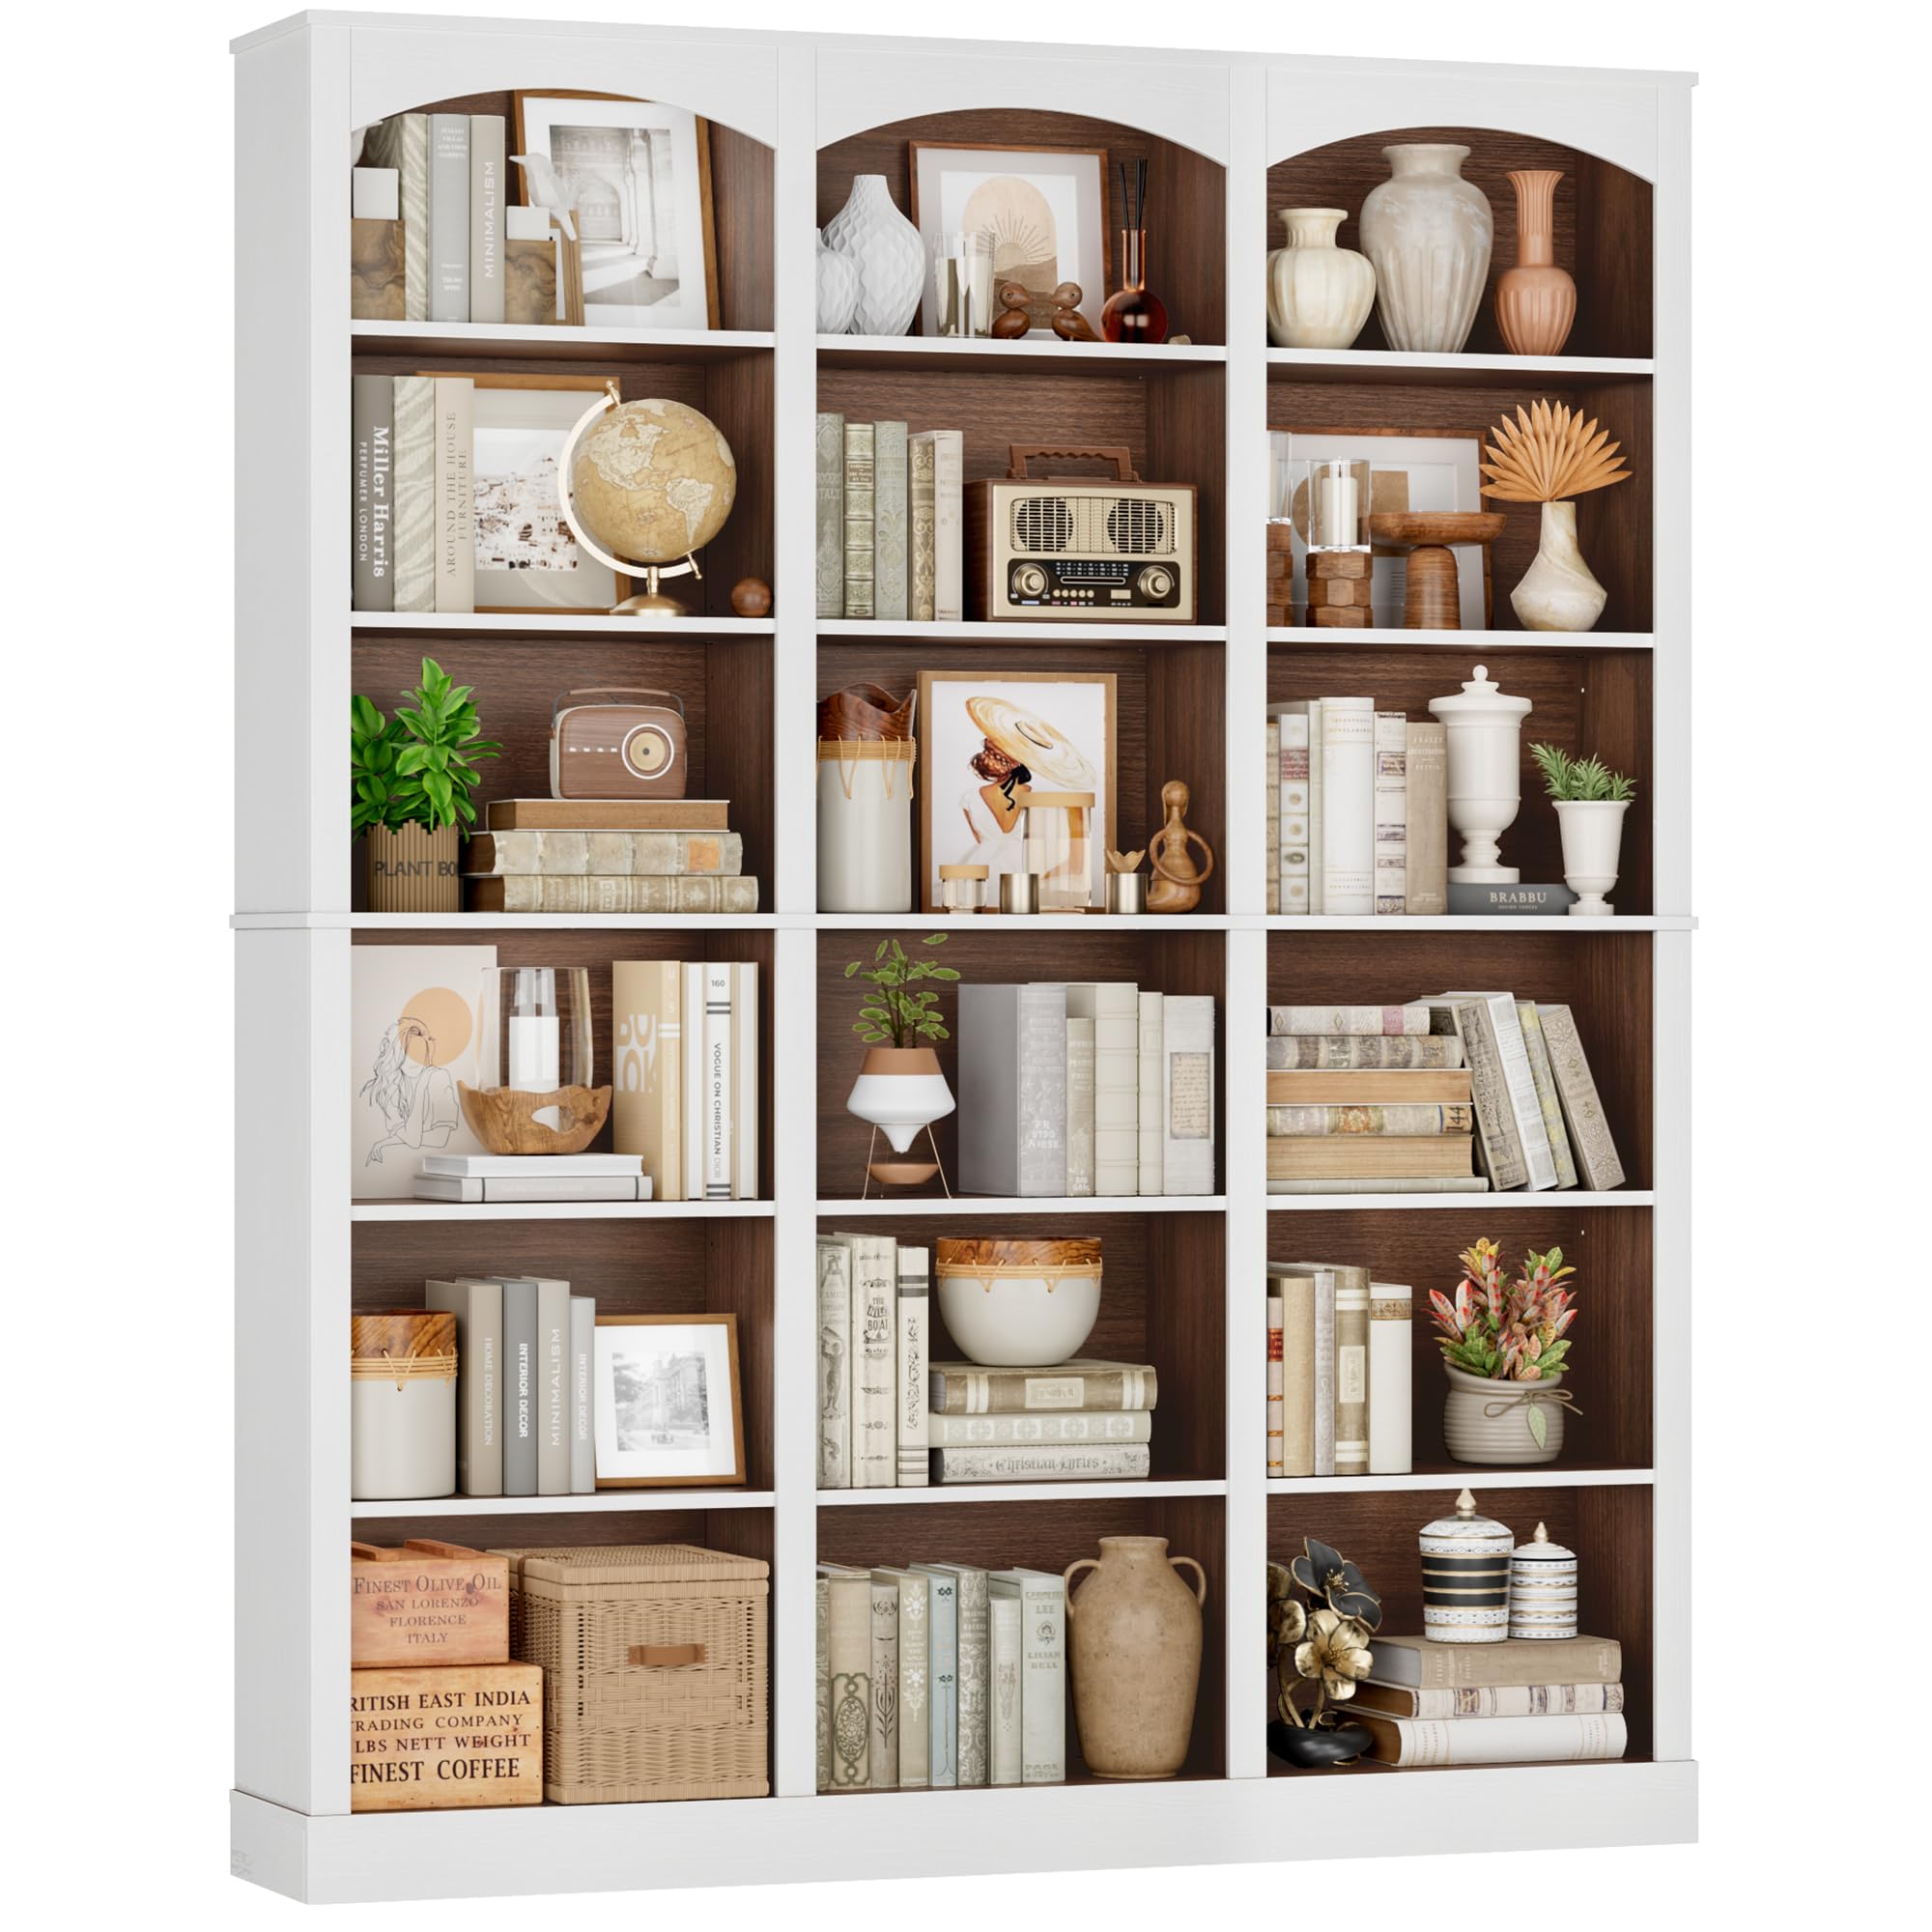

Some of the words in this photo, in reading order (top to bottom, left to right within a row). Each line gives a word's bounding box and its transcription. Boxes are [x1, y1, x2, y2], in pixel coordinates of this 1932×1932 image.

[484, 161, 495, 278] MINIMALISM
[446, 412, 456, 465] HOUSE
[359, 441, 368, 502] PERFUMER
[373, 426, 389, 497] Miller
[446, 471, 456, 503] THE
[458, 449, 468, 540] FURNITURE
[359, 508, 368, 561] LONDON
[373, 504, 389, 578] Harris
[446, 509, 456, 578] AROUND
[375, 861, 433, 877] PLANT
[1490, 892, 1547, 904] BRABBU
[714, 1081, 722, 1097] ON
[485, 1337, 494, 1371] HOME
[519, 1343, 528, 1397] INTERIOR
[552, 1328, 561, 1446] MINIMALISM
[485, 1374, 494, 1446] DECORATION
[519, 1399, 528, 1438] DECOR
[376, 1599, 405, 1611] SAN
[412, 1597, 480, 1609] LORENZO
[389, 1614, 467, 1628] FLORENCE
[1036, 1605, 1056, 1614] LEE
[408, 1633, 449, 1644] ITALY
[350, 1695, 411, 1712] RITISH
[418, 1692, 467, 1709] EAST
[474, 1690, 531, 1707] INDIA
[351, 1718, 424, 1733] RADING
[435, 1714, 524, 1729] COMPANY
[355, 1739, 387, 1754] LBS
[396, 1736, 446, 1751] NETT
[455, 1734, 531, 1748] WEIGHT
[350, 1760, 424, 1784] FINEST
[437, 1757, 520, 1780] COFFEE
